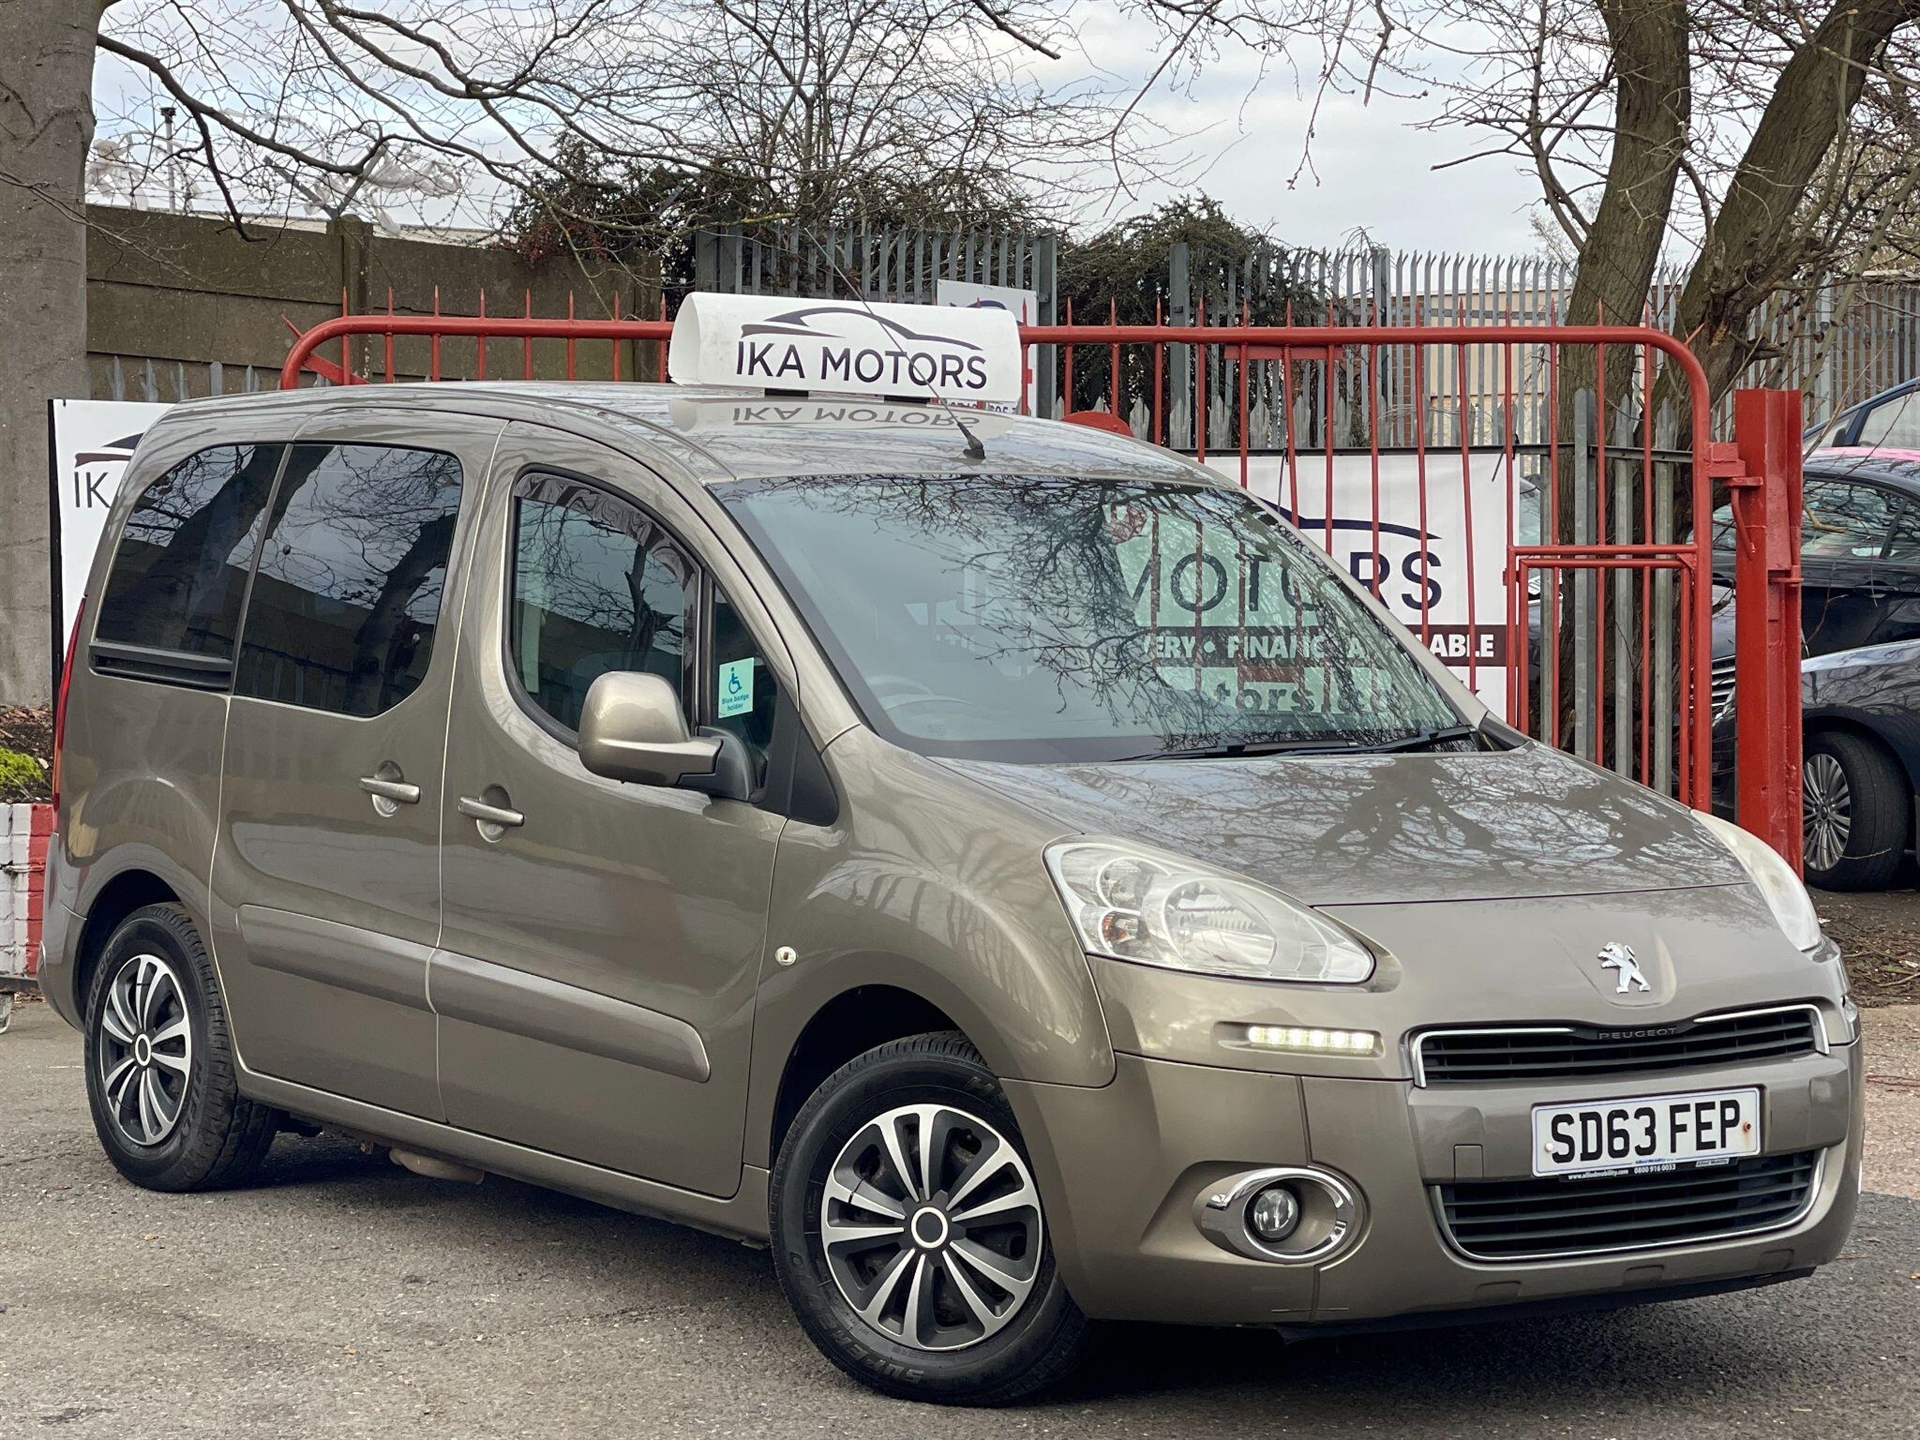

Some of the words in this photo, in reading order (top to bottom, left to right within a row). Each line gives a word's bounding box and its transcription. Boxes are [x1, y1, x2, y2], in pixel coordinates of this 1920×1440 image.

[736, 341, 806, 379] IKA
[820, 345, 988, 390] MOTORS
[1227, 635, 1326, 659] FINANC
[1599, 1027, 1678, 1040] PEUGEOT
[1551, 1107, 1656, 1164] SD63
[1669, 1099, 1741, 1153] FEP
